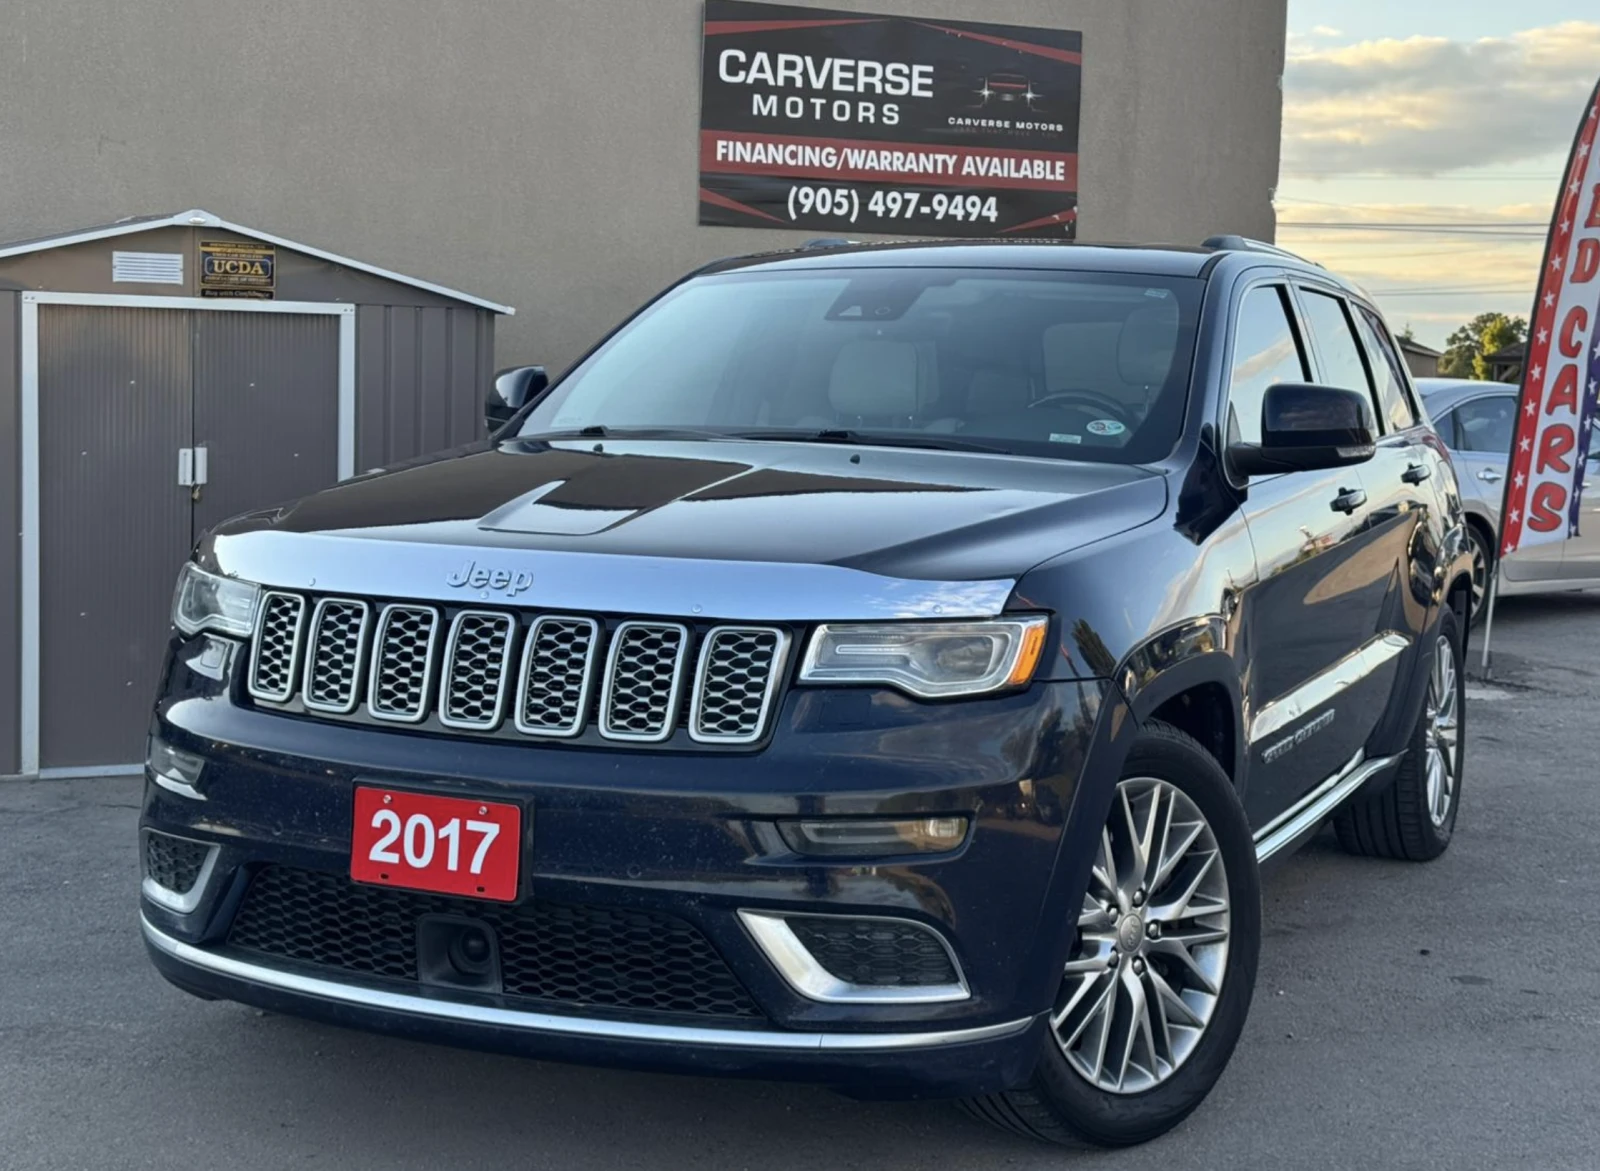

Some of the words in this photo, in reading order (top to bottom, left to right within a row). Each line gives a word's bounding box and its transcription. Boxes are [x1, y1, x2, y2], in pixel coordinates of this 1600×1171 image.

[719, 49, 934, 98] CARVERSE
[752, 94, 899, 125] MOTORS
[948, 116, 1011, 129] CARVERSE
[1015, 121, 1063, 132] MOTORS
[716, 140, 957, 175] FINANCING/WARRANTY
[961, 155, 1065, 181] AVAILABLE
[788, 186, 860, 223] (905)
[868, 189, 999, 222] 497-9494
[213, 260, 265, 275] UCDA
[1527, 305, 1587, 533] CARS
[446, 560, 534, 597] Jeep
[368, 808, 500, 874] 2017
